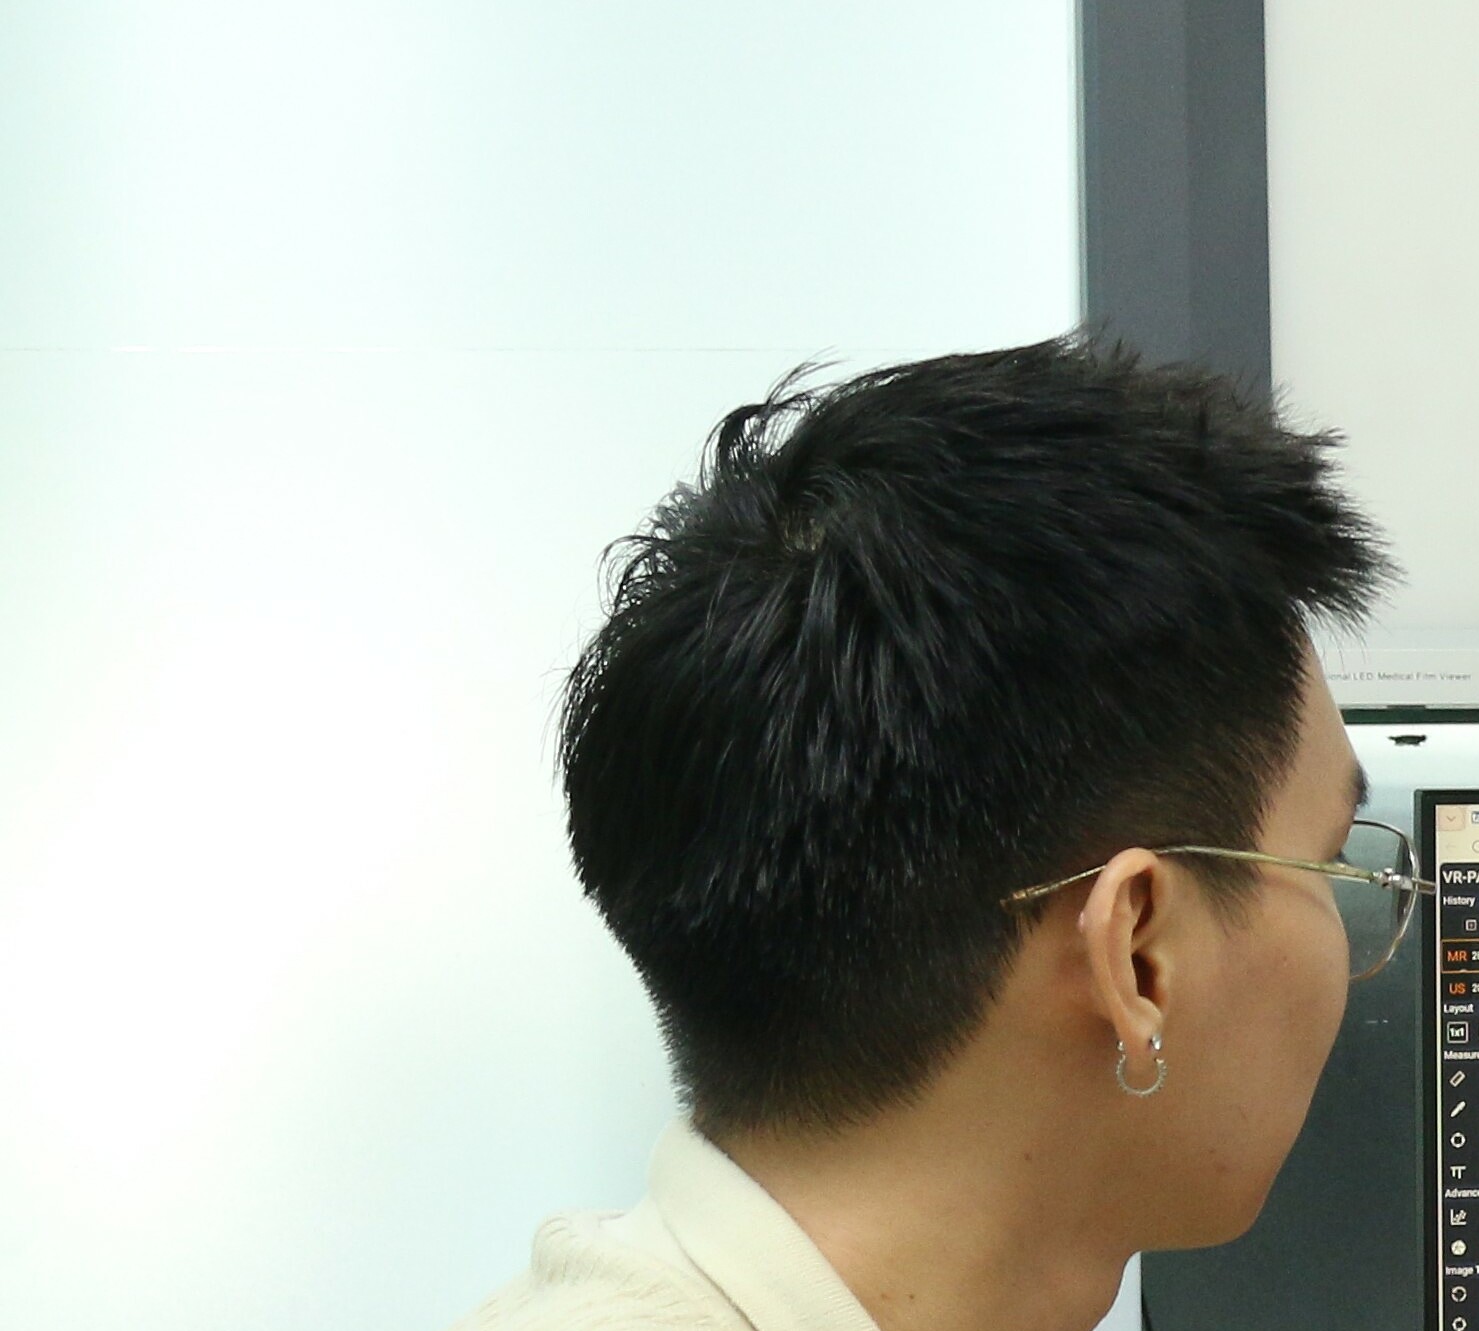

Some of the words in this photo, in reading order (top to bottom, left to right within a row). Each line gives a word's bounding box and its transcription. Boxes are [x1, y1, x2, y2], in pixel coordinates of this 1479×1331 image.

[1378, 672, 1413, 681] Medical
[1440, 672, 1472, 681] Viewer
[1443, 896, 1476, 907] History
[1447, 951, 1468, 962] MR
[1449, 982, 1466, 994] US
[1443, 1003, 1474, 1015] Layout
[1445, 1265, 1474, 1277] Image
